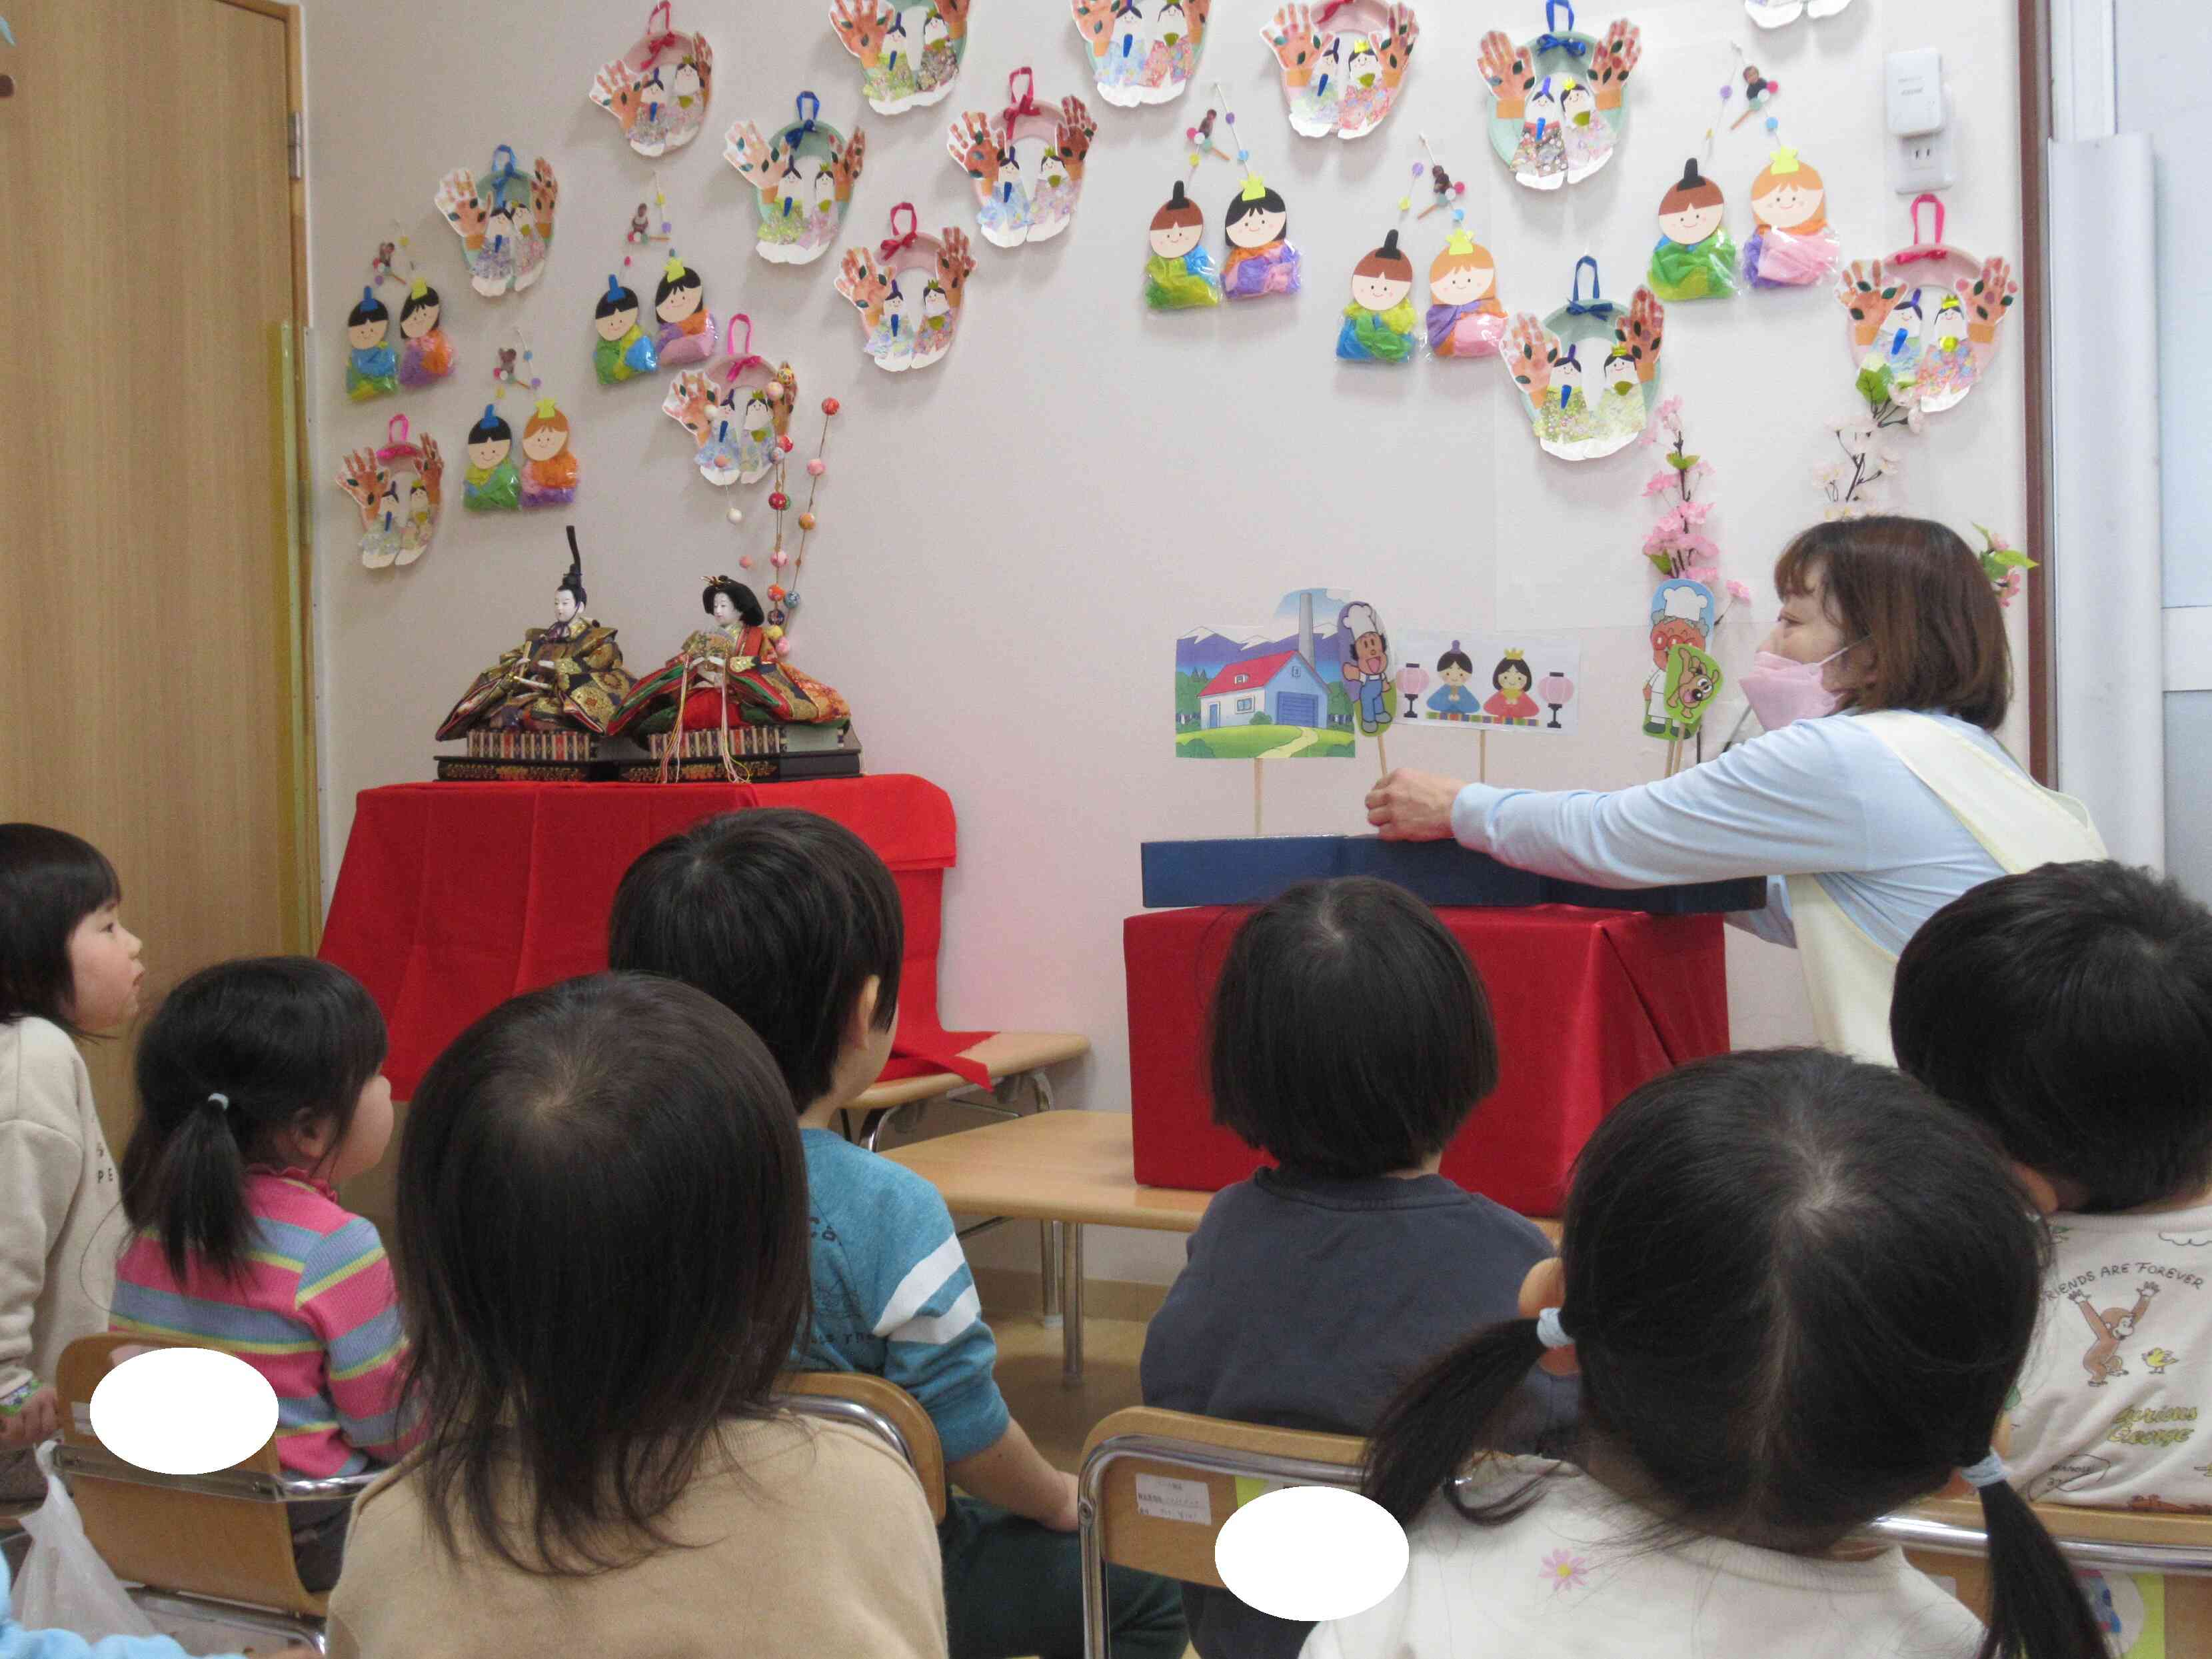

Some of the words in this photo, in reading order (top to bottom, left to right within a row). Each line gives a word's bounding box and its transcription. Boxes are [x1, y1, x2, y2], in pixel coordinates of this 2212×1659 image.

[2044, 1270, 2095, 1300] RIENDS
[2101, 1263, 2130, 1277] ARE
[2135, 1262, 2205, 1290] FOREVER
